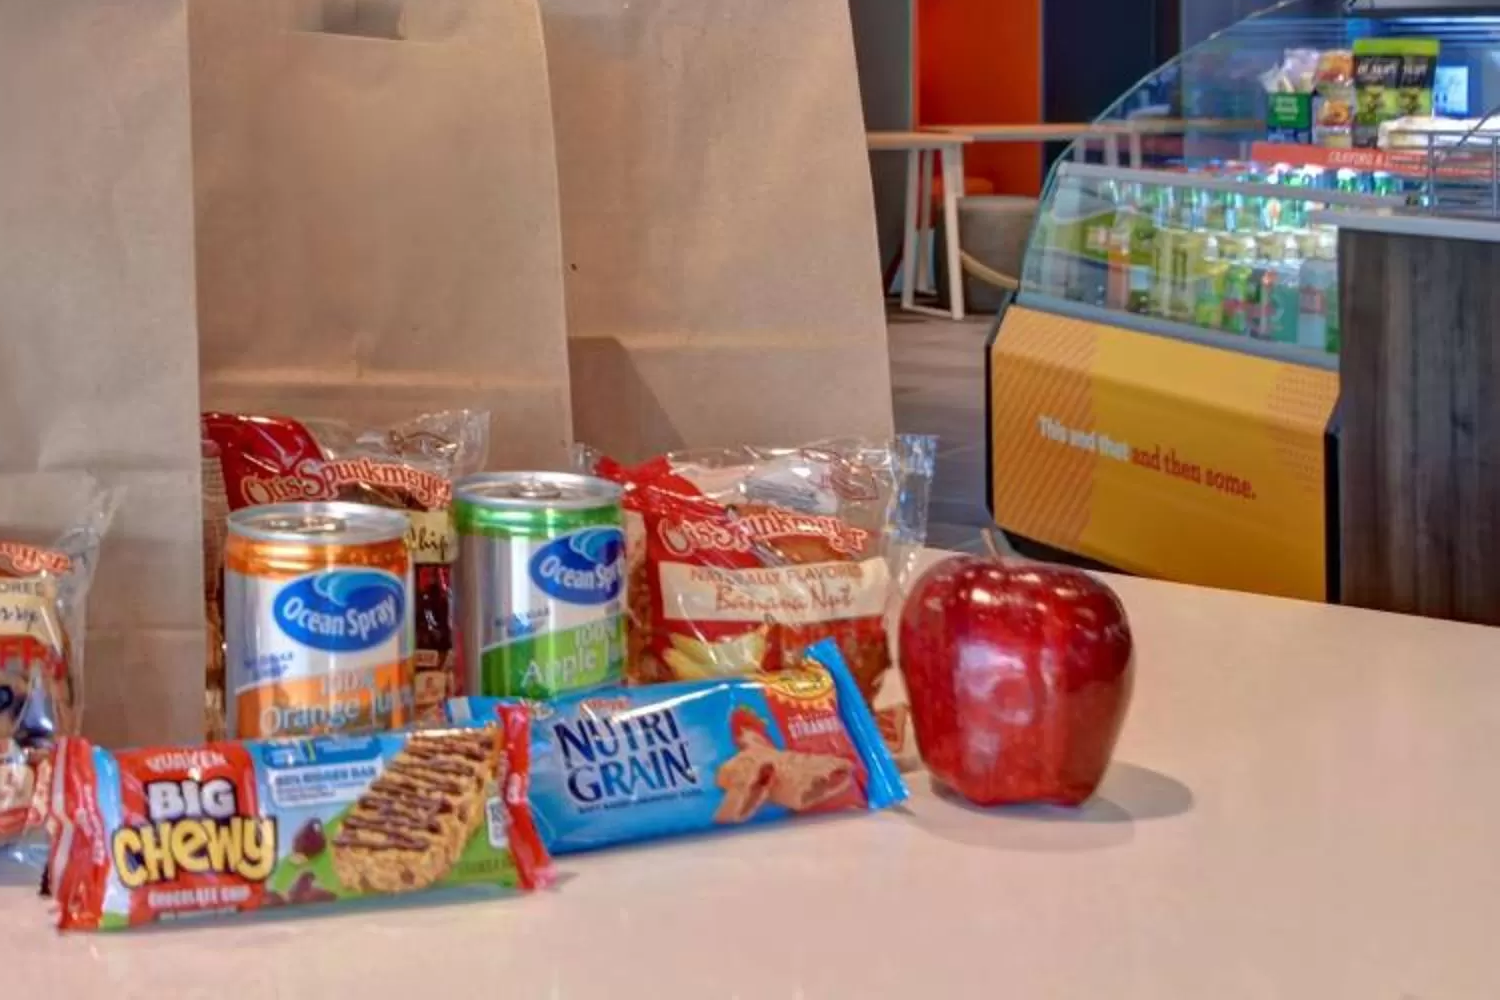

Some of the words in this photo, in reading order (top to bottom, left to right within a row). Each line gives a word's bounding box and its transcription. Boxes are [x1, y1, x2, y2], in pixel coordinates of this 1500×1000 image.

[1132, 444, 1161, 472] and
[1164, 448, 1201, 484] then
[1205, 468, 1257, 500] some.
[540, 555, 595, 590] Ocean
[283, 596, 345, 636] Ocean
[345, 595, 397, 641] Spray
[260, 695, 362, 735] Orange
[553, 708, 680, 769] NUTRI
[567, 741, 698, 803] GRAIN
[147, 778, 237, 821] BIG
